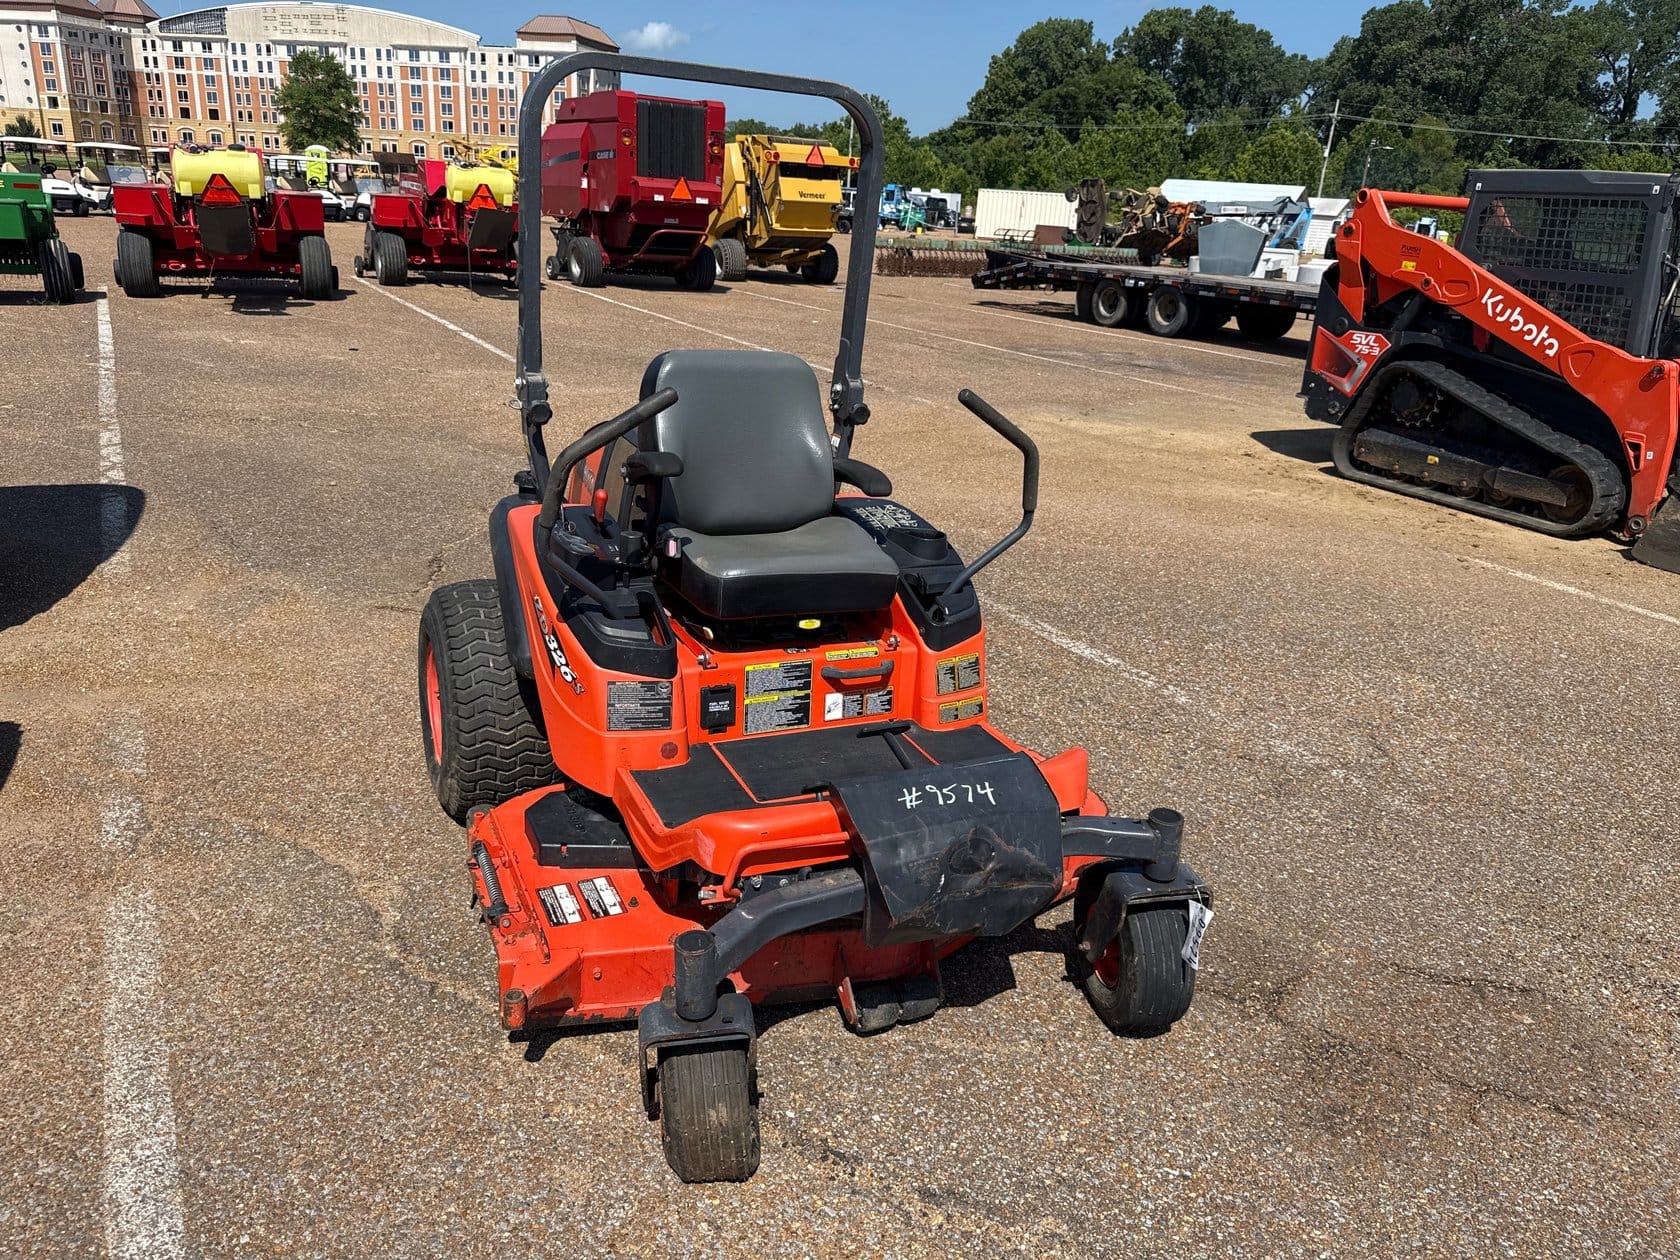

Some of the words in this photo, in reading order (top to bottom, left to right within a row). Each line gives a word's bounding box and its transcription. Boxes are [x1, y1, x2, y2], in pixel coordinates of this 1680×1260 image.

[798, 190, 826, 199] Vermeer
[1481, 287, 1559, 357] Kubota
[1350, 333, 1379, 346] SVL
[1354, 344, 1380, 355] 75-3
[897, 781, 996, 809] #9574
